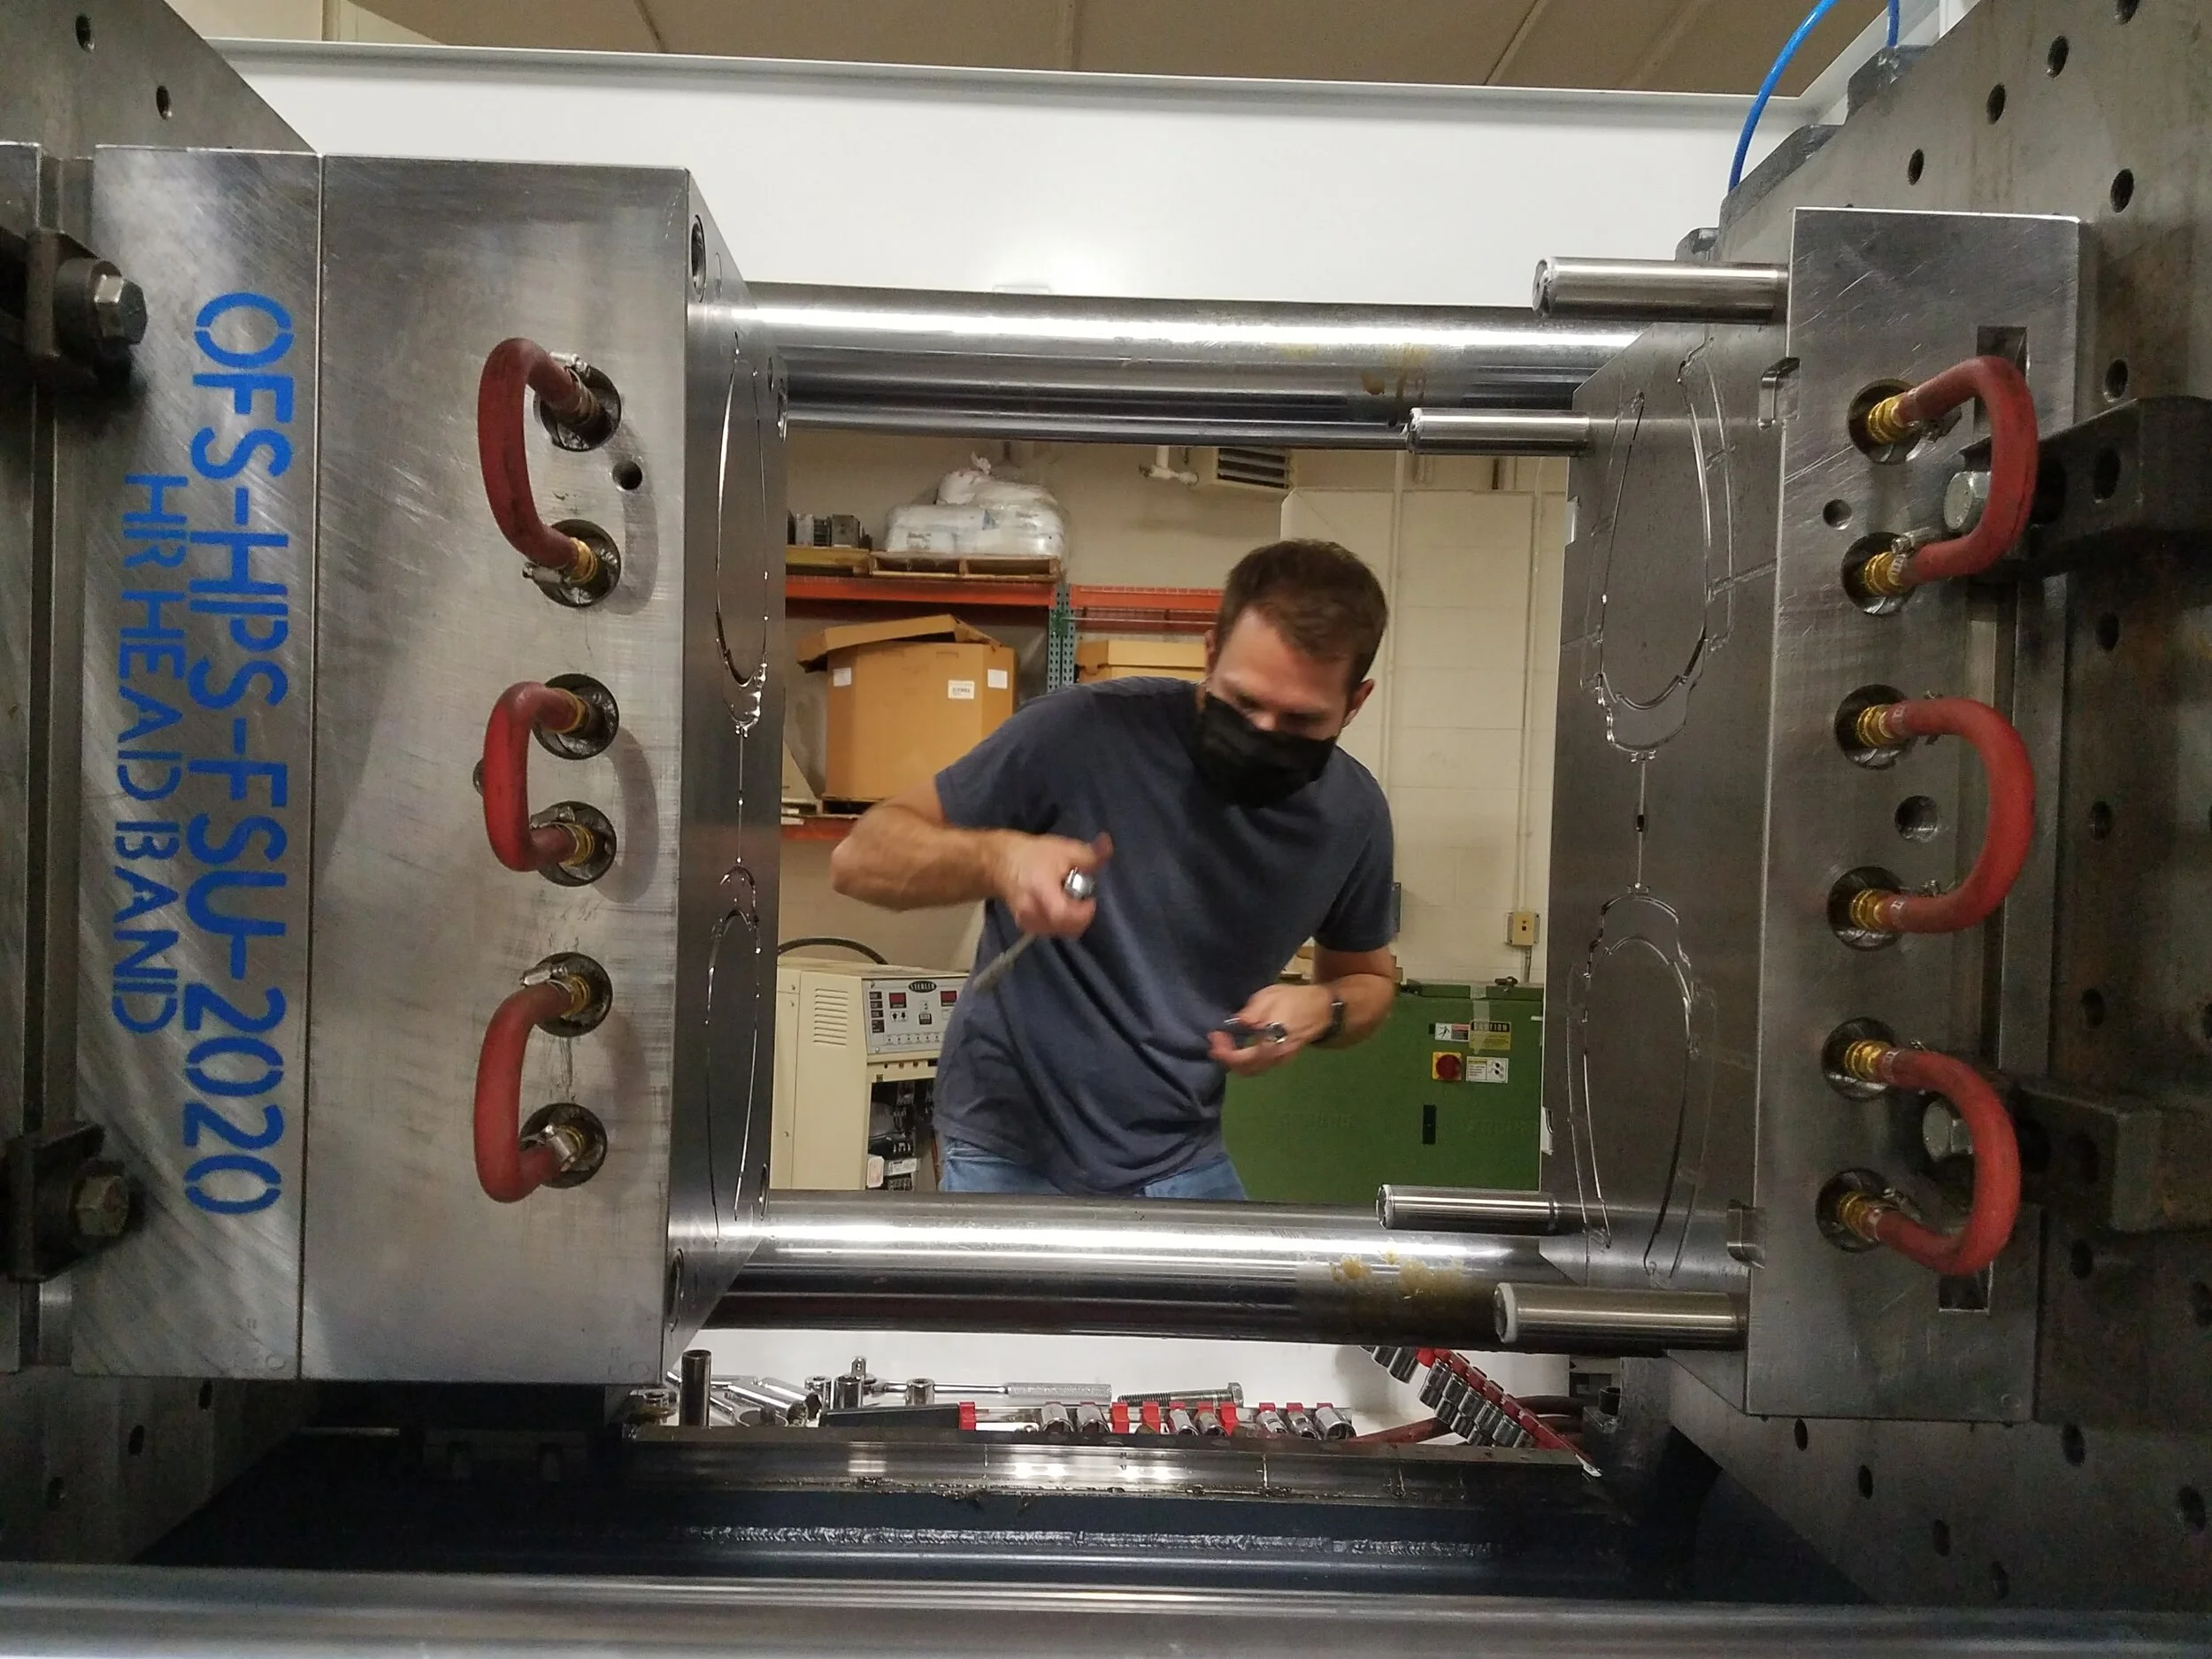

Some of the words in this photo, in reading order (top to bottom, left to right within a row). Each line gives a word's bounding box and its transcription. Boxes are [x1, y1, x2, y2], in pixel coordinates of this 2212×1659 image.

[122, 473, 188, 568] HR
[118, 588, 187, 801] HEAD
[184, 292, 296, 1212] OFS-HPS-FSU-2020
[113, 821, 180, 1033] BAND
